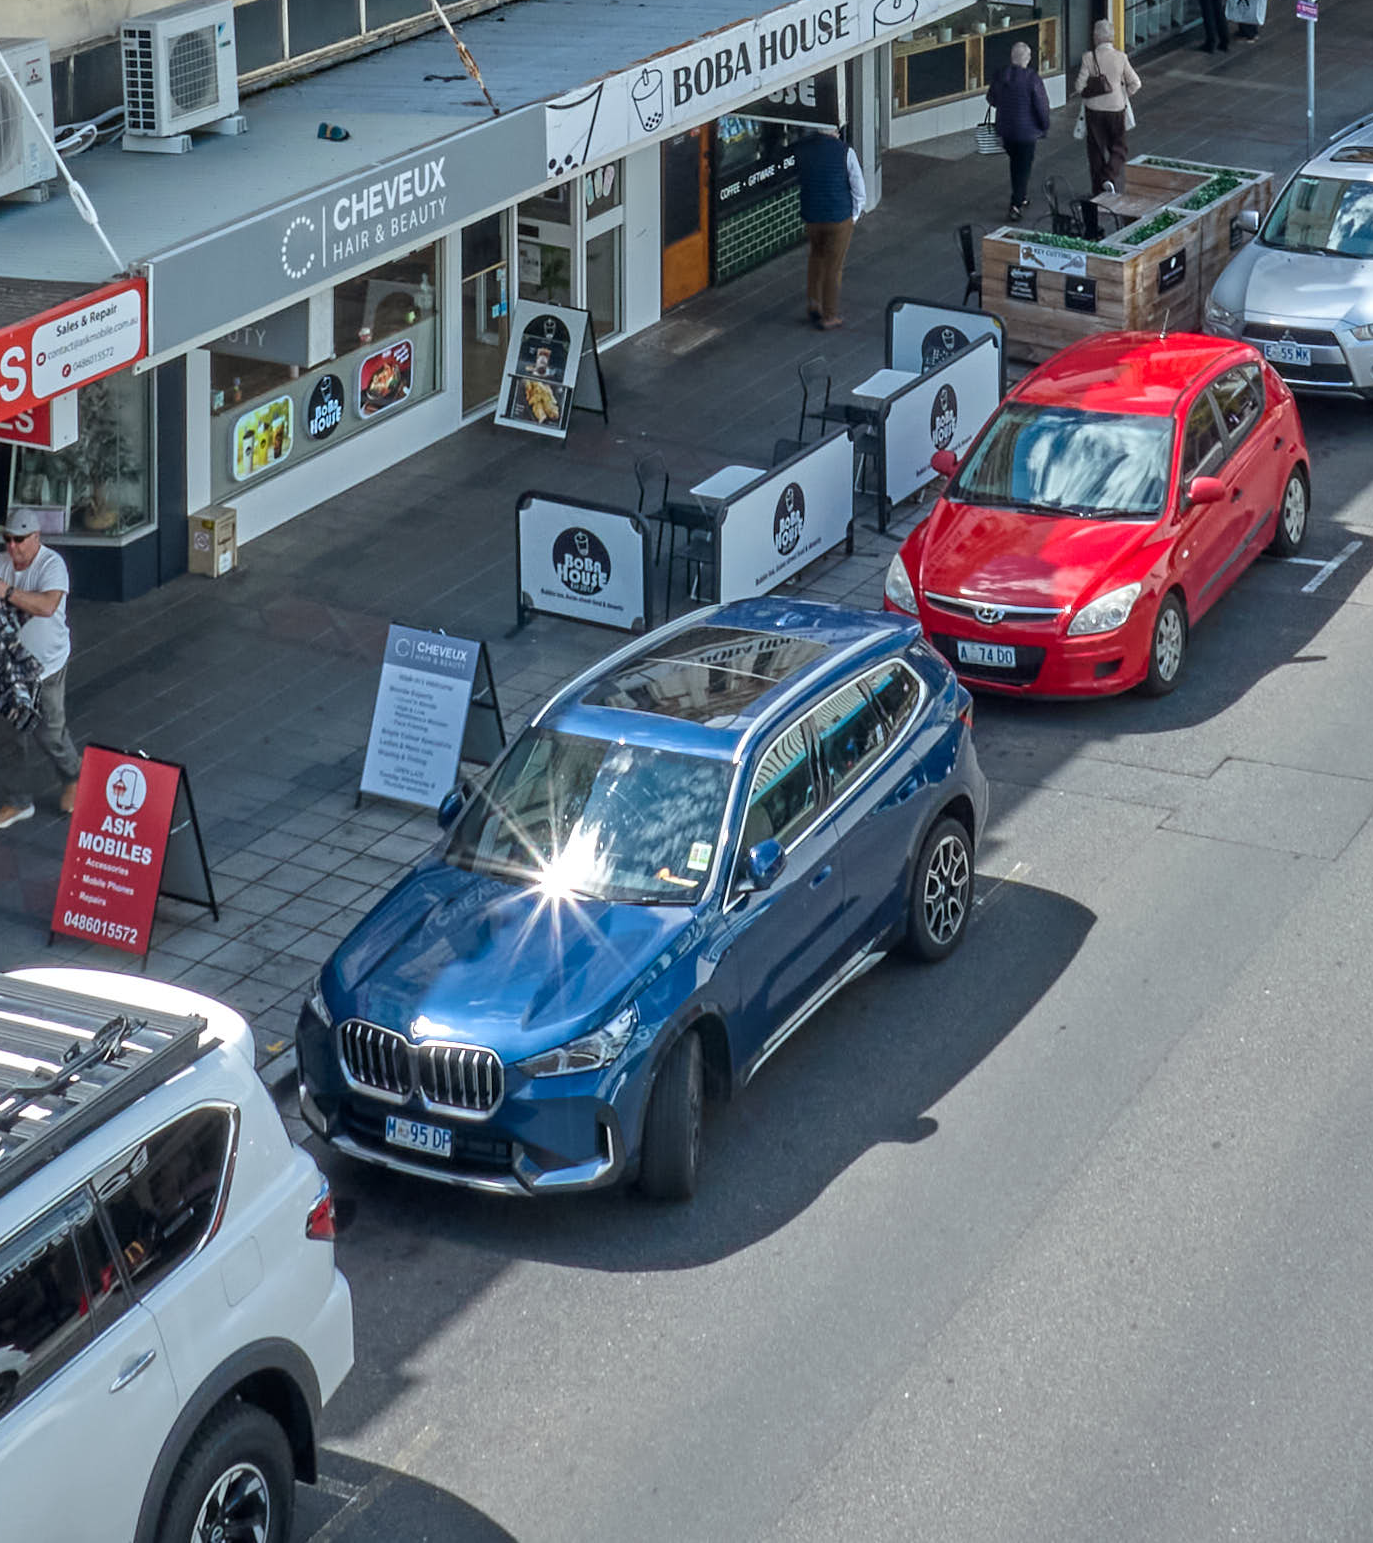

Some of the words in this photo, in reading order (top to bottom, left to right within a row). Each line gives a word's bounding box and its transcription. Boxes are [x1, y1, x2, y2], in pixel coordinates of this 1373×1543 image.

[673, 42, 753, 108] BOBA
[759, 2, 850, 70] HOUSE
[333, 157, 446, 231] CHEVEUX
[719, 181, 741, 201] COFFEE
[333, 234, 369, 263] HAIR
[375, 224, 385, 244] &
[390, 196, 447, 238] BEAUTY
[56, 321, 79, 337] Sales
[81, 314, 88, 328] &
[90, 303, 118, 326] Repair
[315, 399, 339, 418] BOBA
[310, 410, 342, 435] HOUSE
[557, 563, 607, 588] HOUSE
[564, 553, 602, 574] BOBA
[417, 641, 468, 662] CHEVEUX
[101, 814, 137, 838] ASK
[78, 831, 152, 865] MOBILES
[85, 857, 129, 876] Accessories
[63, 909, 138, 944] 0486015572
[410, 1123, 428, 1146] 95
[432, 1127, 452, 1150] DP
